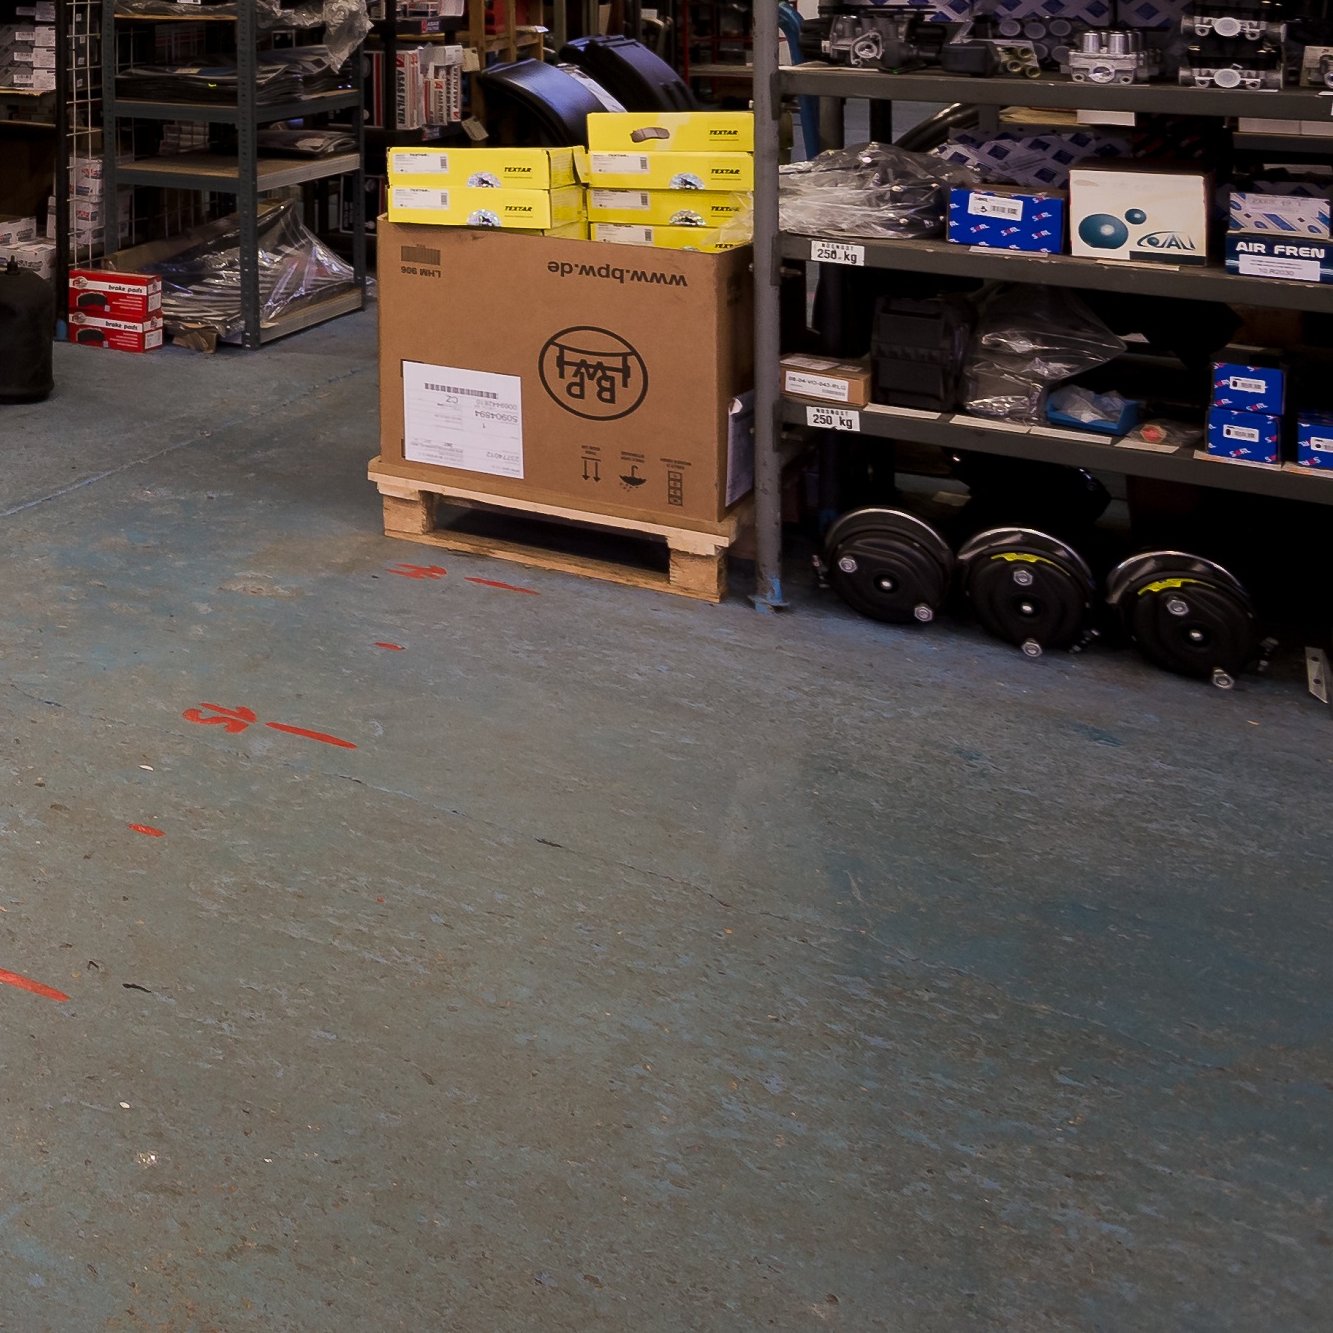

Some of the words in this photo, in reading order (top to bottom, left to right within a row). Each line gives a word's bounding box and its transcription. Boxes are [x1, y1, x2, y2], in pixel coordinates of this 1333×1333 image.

[396, 70, 406, 93] ASAS
[396, 94, 406, 125] FILTER
[709, 129, 738, 137] TEXTAR
[504, 166, 533, 175] TEXTAR
[710, 168, 741, 176] TEXTAR
[504, 205, 534, 213] TEXTAR
[1235, 241, 1270, 255] AIR
[1274, 244, 1327, 259] FREN
[840, 250, 859, 266] kg
[400, 265, 418, 276] 906
[419, 267, 442, 279] LHM
[547, 259, 688, 287] www.bpw.de
[108, 283, 127, 292] brake
[128, 286, 143, 295] pads
[104, 319, 122, 328] brake
[123, 322, 139, 332] pads
[812, 412, 834, 427] 250
[839, 415, 855, 431] kg
